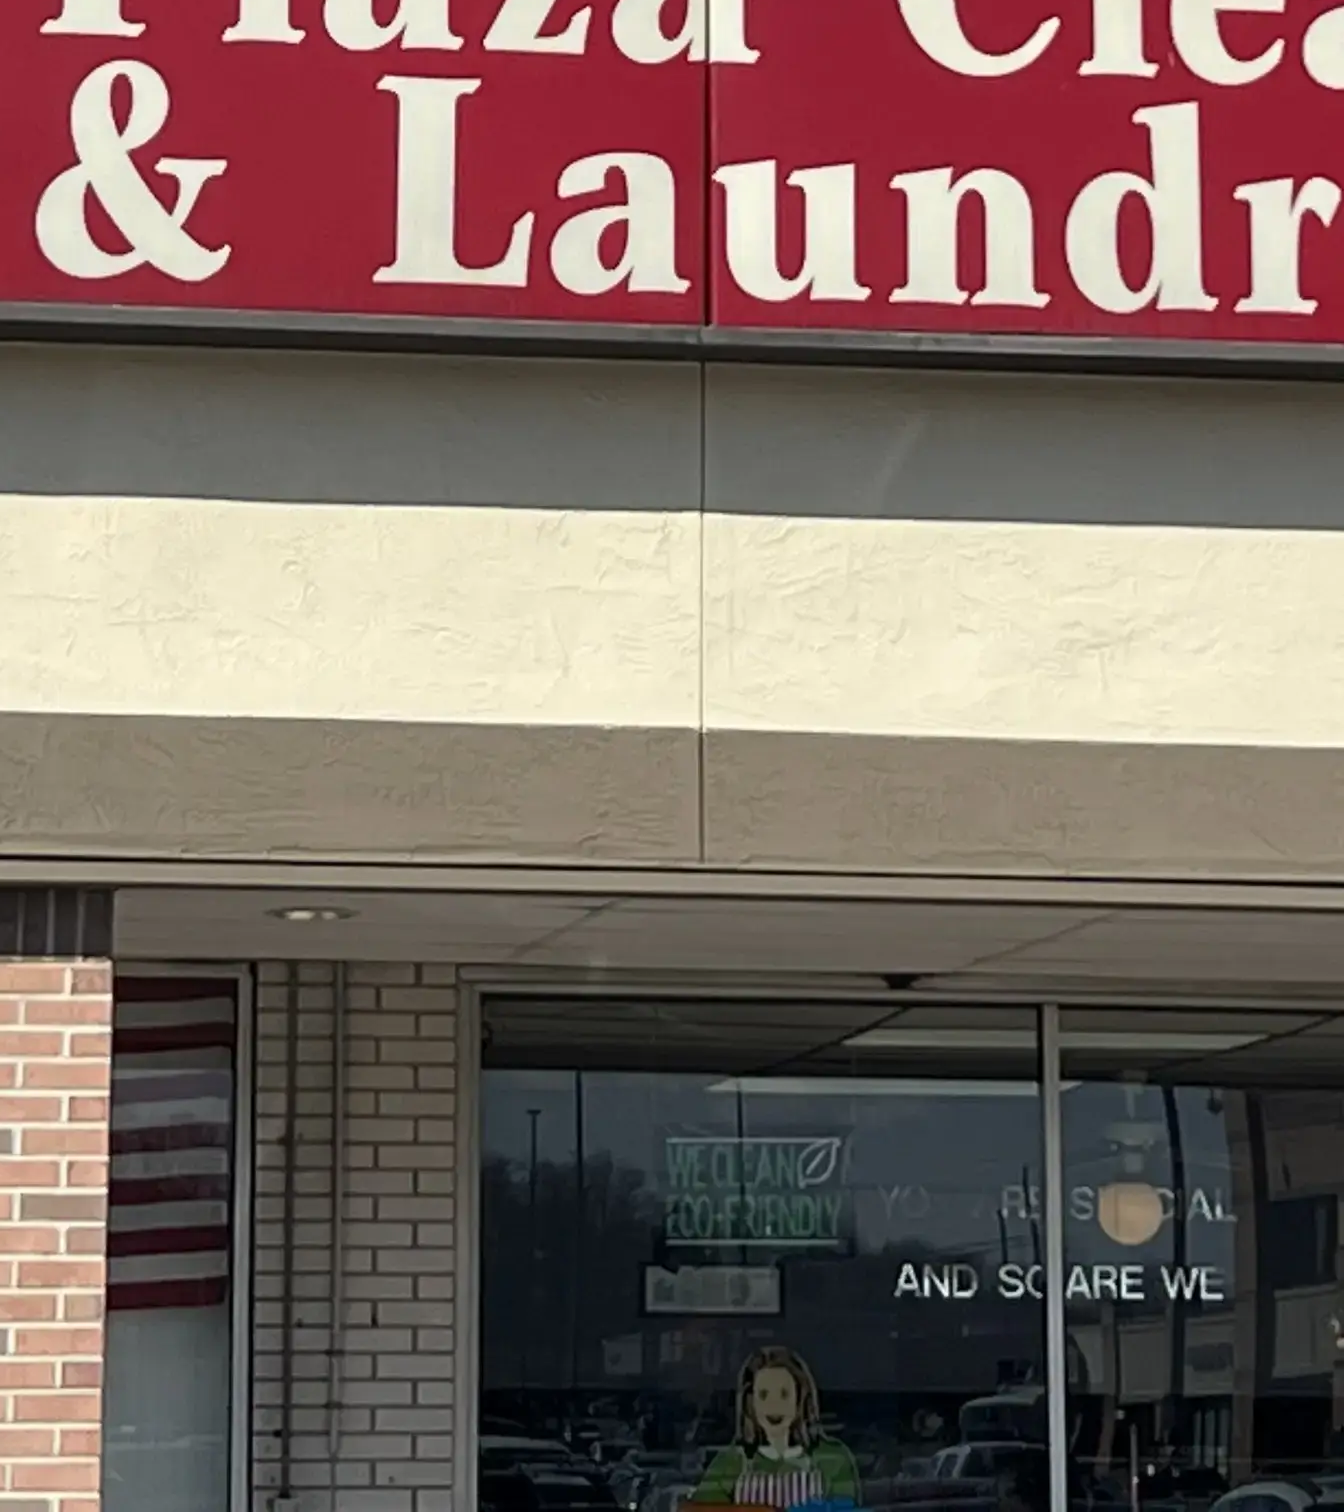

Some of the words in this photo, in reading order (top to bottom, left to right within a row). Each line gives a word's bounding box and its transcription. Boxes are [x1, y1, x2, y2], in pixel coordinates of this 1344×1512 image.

[35, 59, 232, 283] &
[894, 1262, 979, 1299] AND
[1065, 1265, 1144, 1301] ARE
[1160, 1265, 1225, 1301] WE
